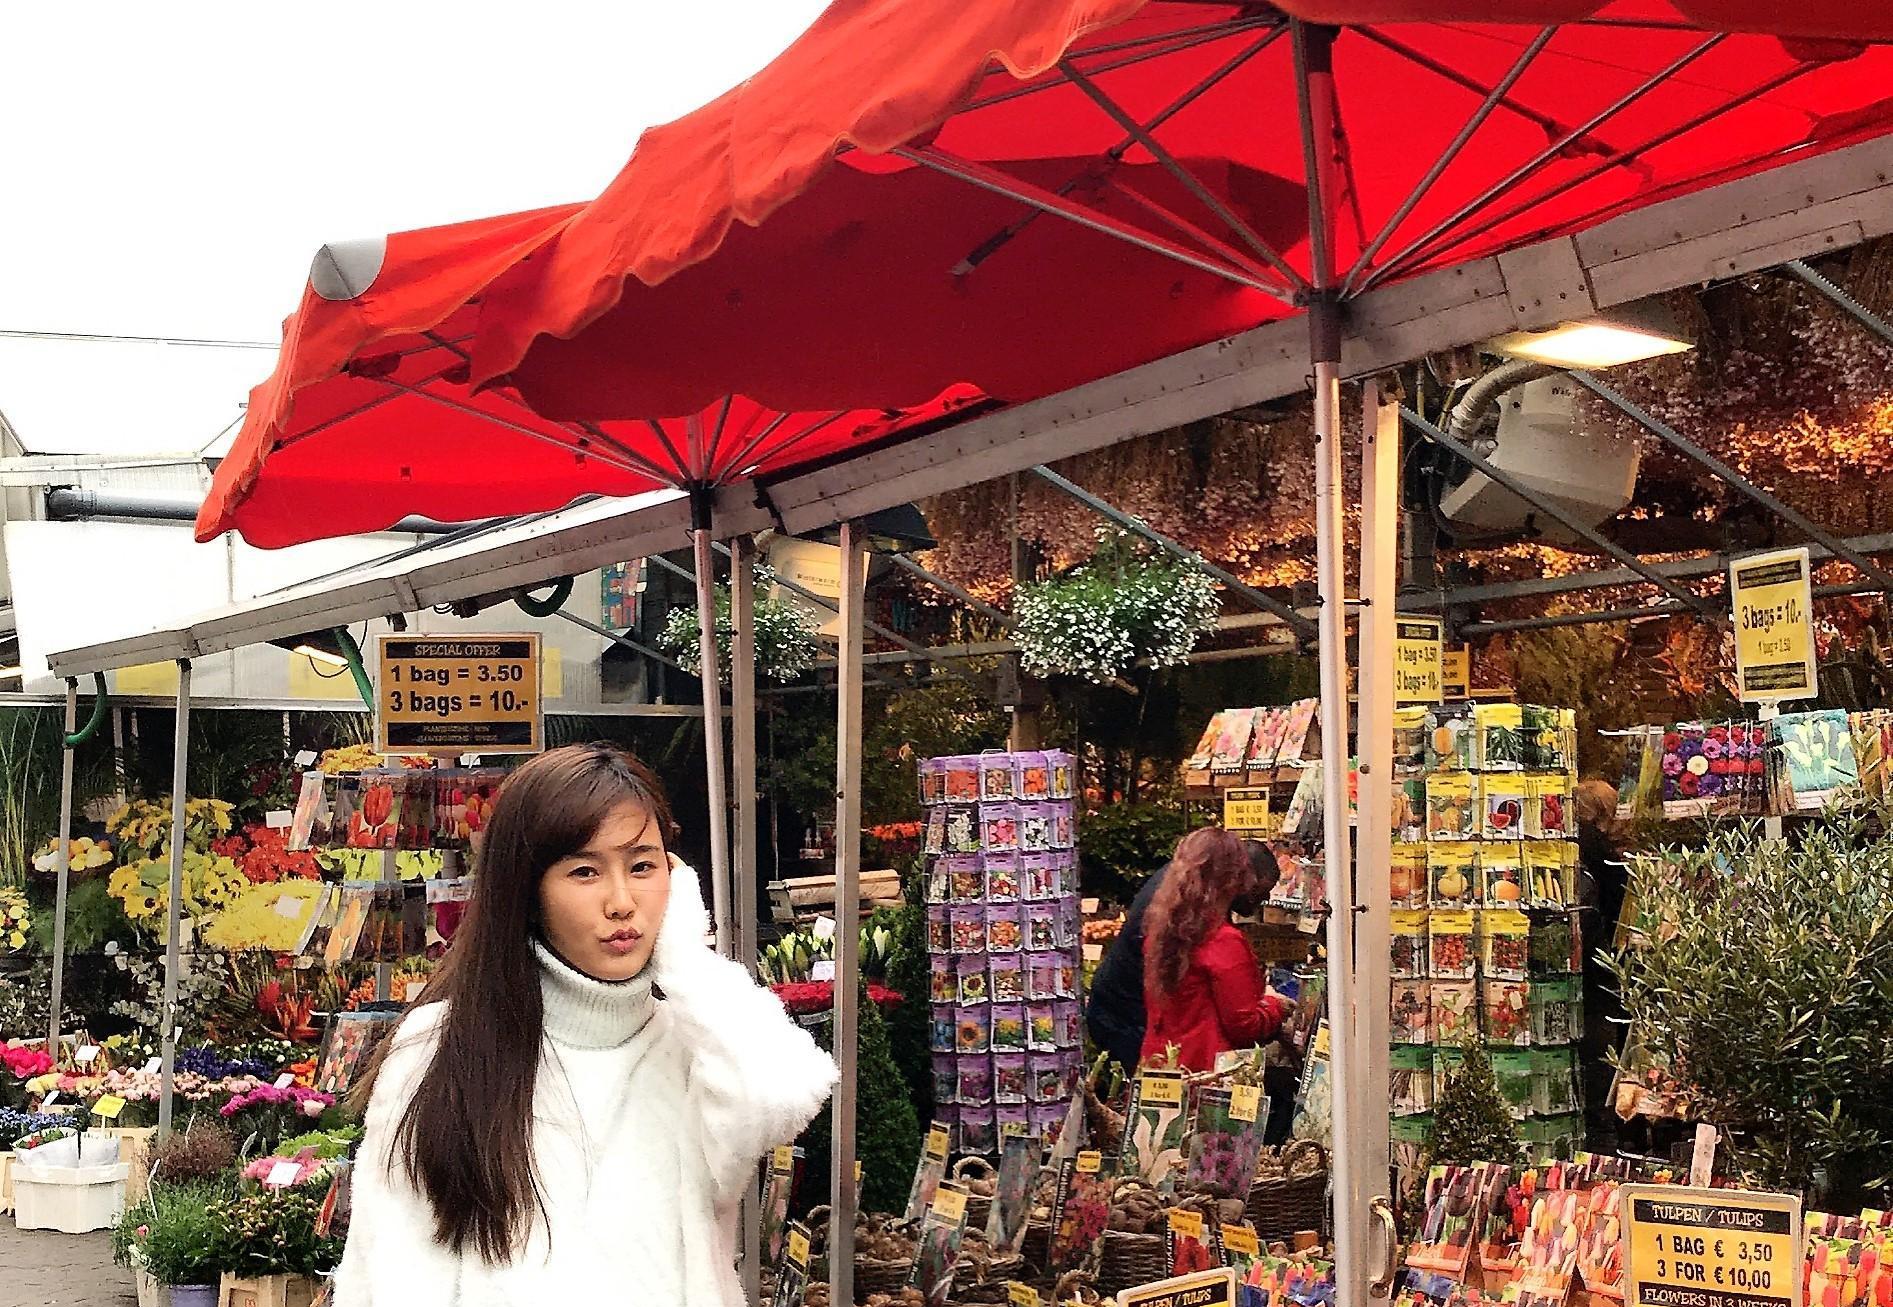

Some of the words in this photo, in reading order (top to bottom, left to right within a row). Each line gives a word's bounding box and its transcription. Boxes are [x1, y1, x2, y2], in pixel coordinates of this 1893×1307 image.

[1742, 605, 1749, 630] 3
[1751, 605, 1775, 634] bags
[414, 644, 462, 657] SPECIAL
[464, 644, 502, 657] OFFER
[391, 665, 401, 682] 1
[410, 665, 450, 686] bag
[477, 665, 523, 682] 3.50
[390, 690, 403, 712] 3
[410, 691, 462, 717] bags
[490, 690, 529, 712] 10.-
[1652, 1204, 1702, 1223] TULPEN
[1718, 1210, 1764, 1227] TULIPS
[1656, 1234, 1664, 1251] 1
[1673, 1236, 1705, 1256] BAG
[1714, 1240, 1724, 1258] €
[1739, 1242, 1773, 1264] 3,50
[1657, 1260, 1666, 1277] 3
[1675, 1261, 1706, 1282] FOR
[1714, 1266, 1724, 1284] €
[1728, 1267, 1771, 1291] 10,00
[1182, 1288, 1212, 1307] TULIPS
[1645, 1288, 1707, 1307] FLOWERS
